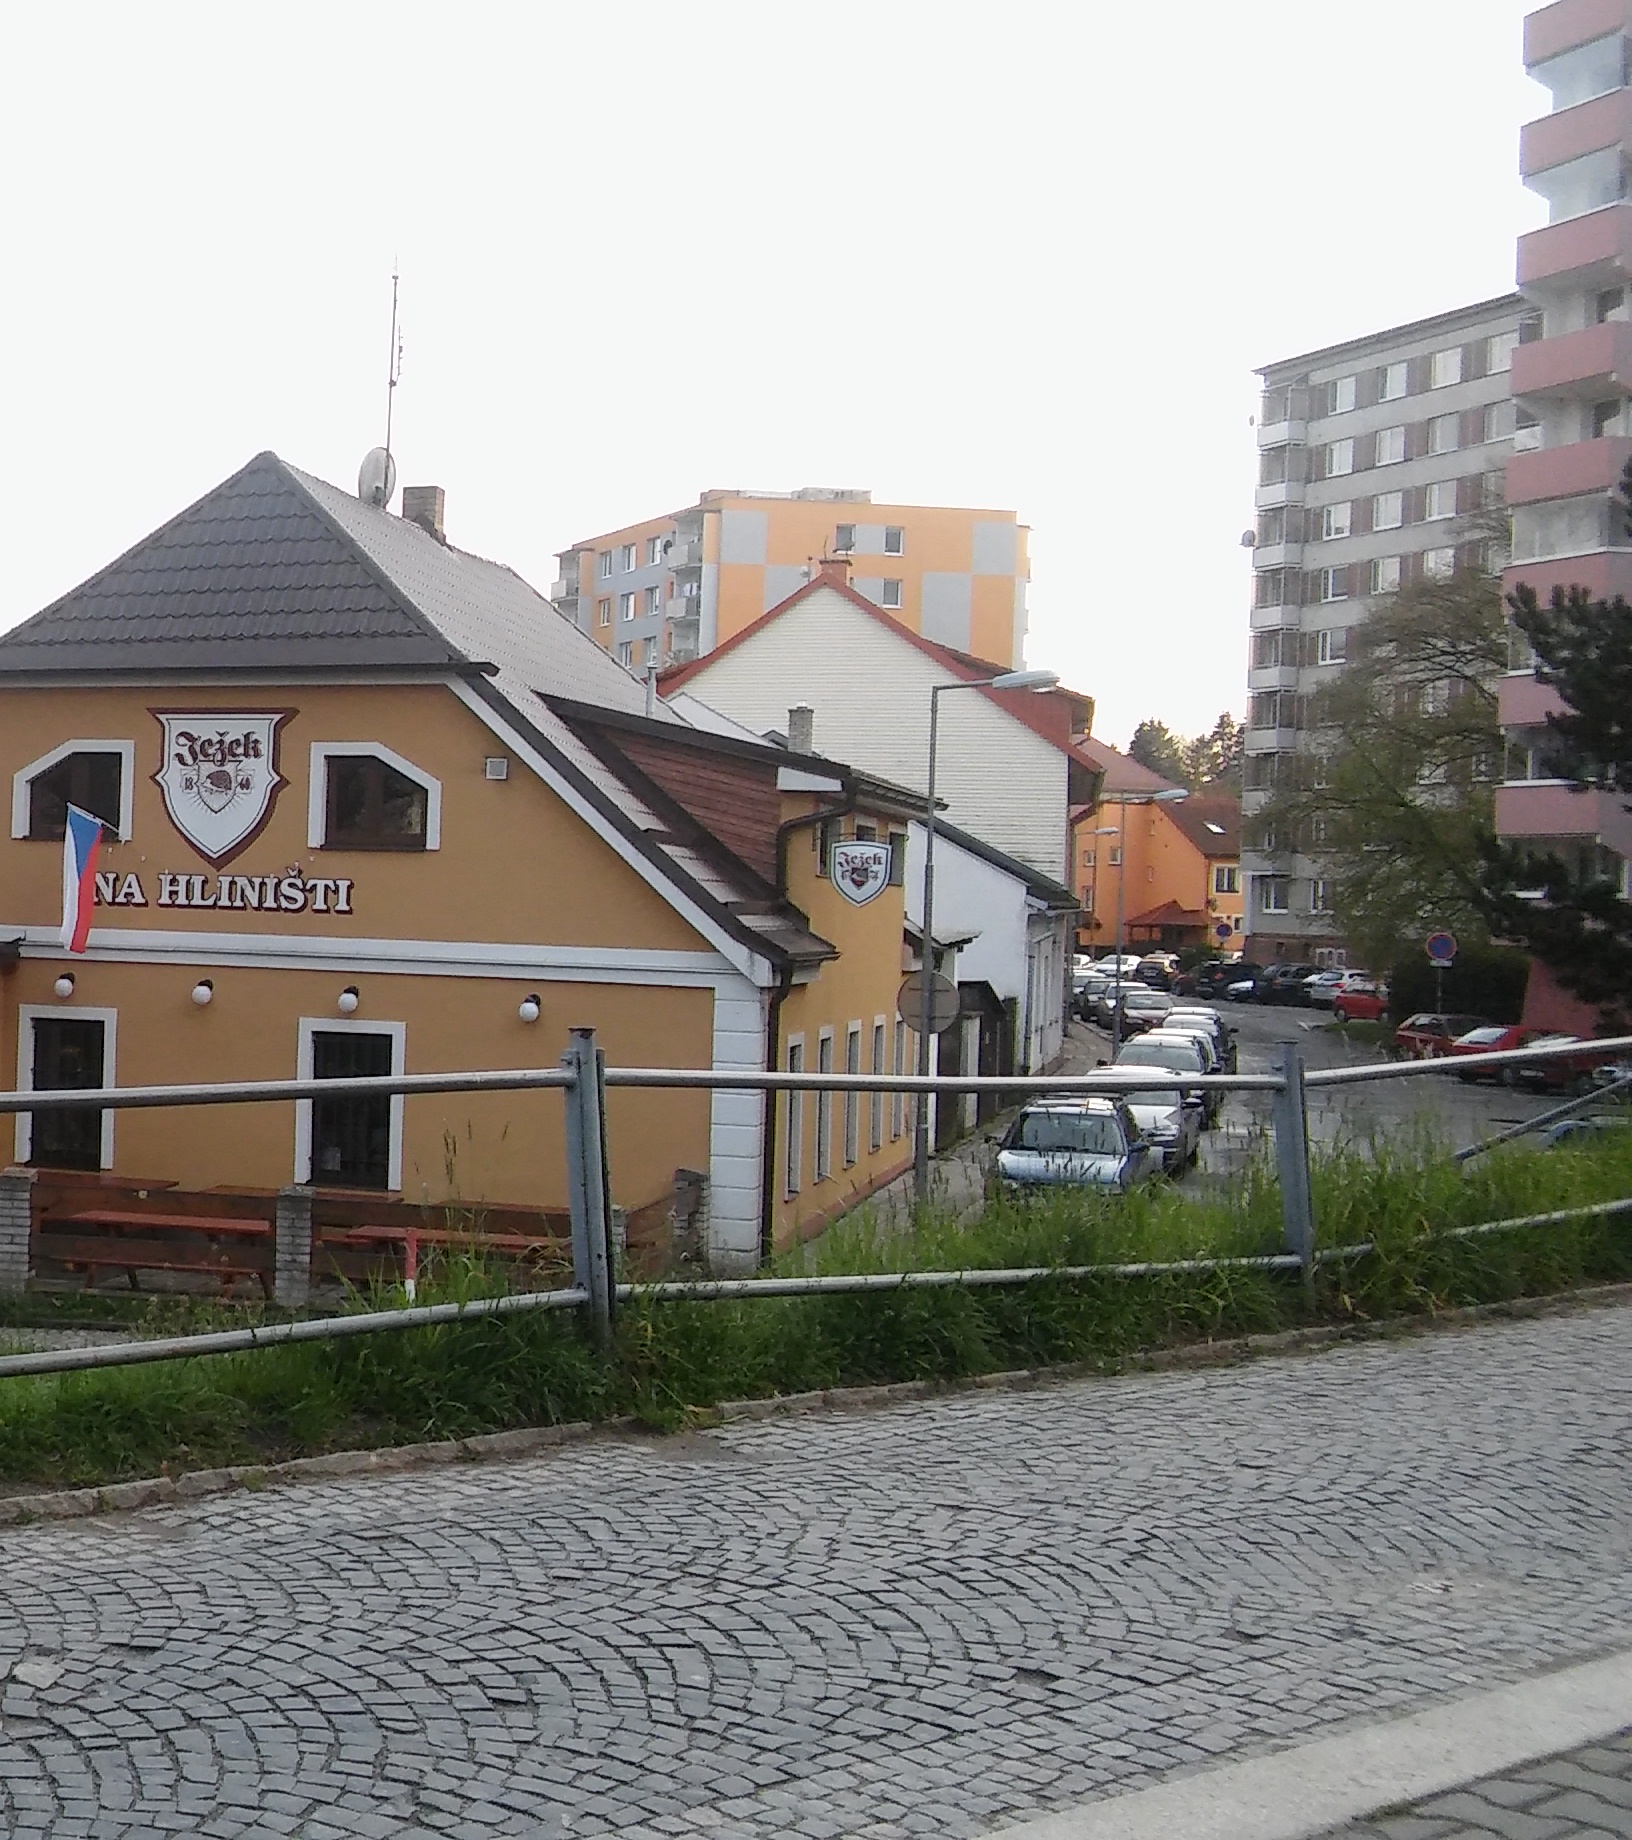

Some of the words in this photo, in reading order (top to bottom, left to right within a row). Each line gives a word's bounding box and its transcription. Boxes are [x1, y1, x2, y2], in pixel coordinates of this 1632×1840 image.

[174, 730, 264, 767] Ježek
[837, 851, 884, 868] Ježek
[93, 872, 148, 906] NA
[157, 867, 353, 913] HLINIŠTI
